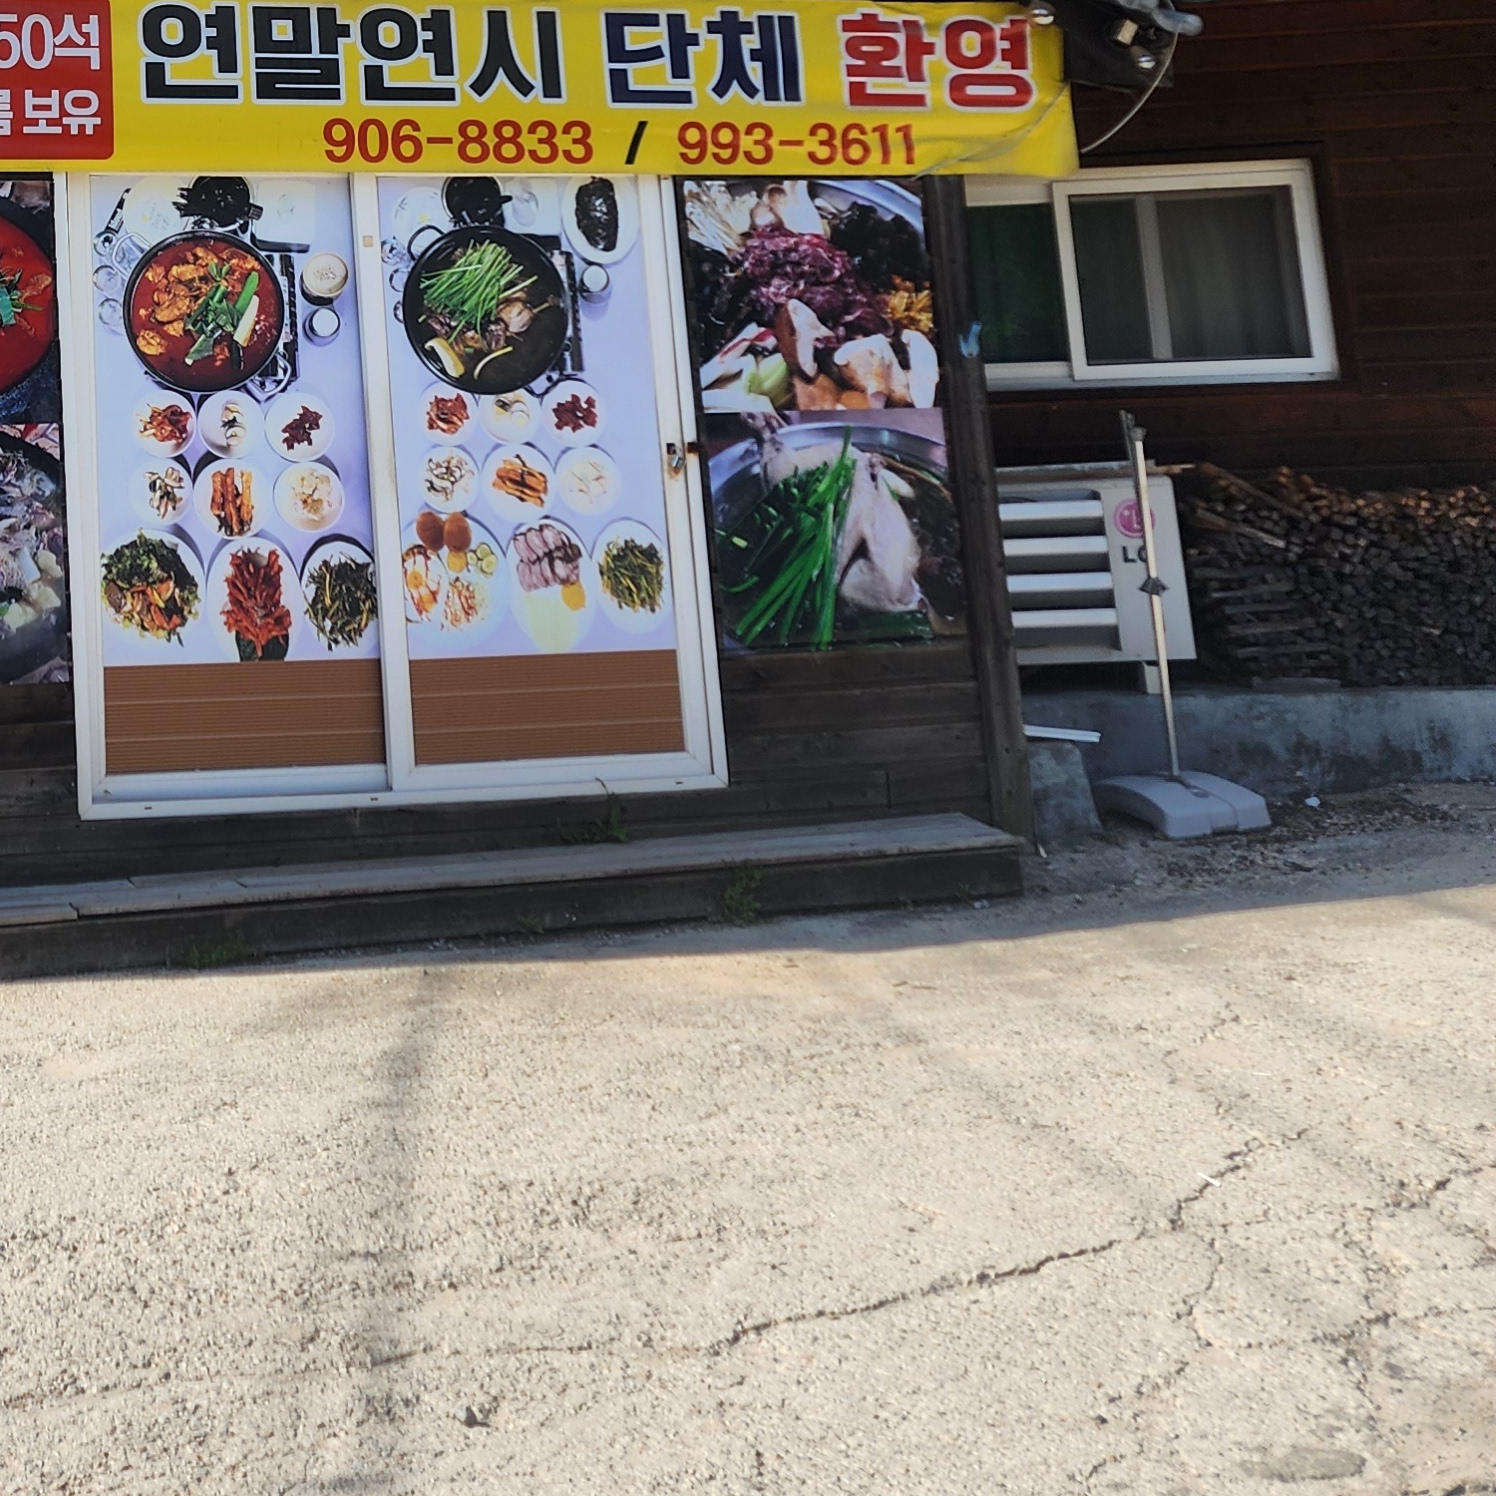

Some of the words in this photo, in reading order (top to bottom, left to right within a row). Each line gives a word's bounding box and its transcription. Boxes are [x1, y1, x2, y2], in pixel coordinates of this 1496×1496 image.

[142, 4, 563, 104] 연말연시
[604, 10, 802, 104] 단체
[841, 12, 1034, 108] 환영
[22, 89, 102, 136] 보유
[324, 118, 593, 164] 906-8833
[678, 121, 917, 166] 993-3611
